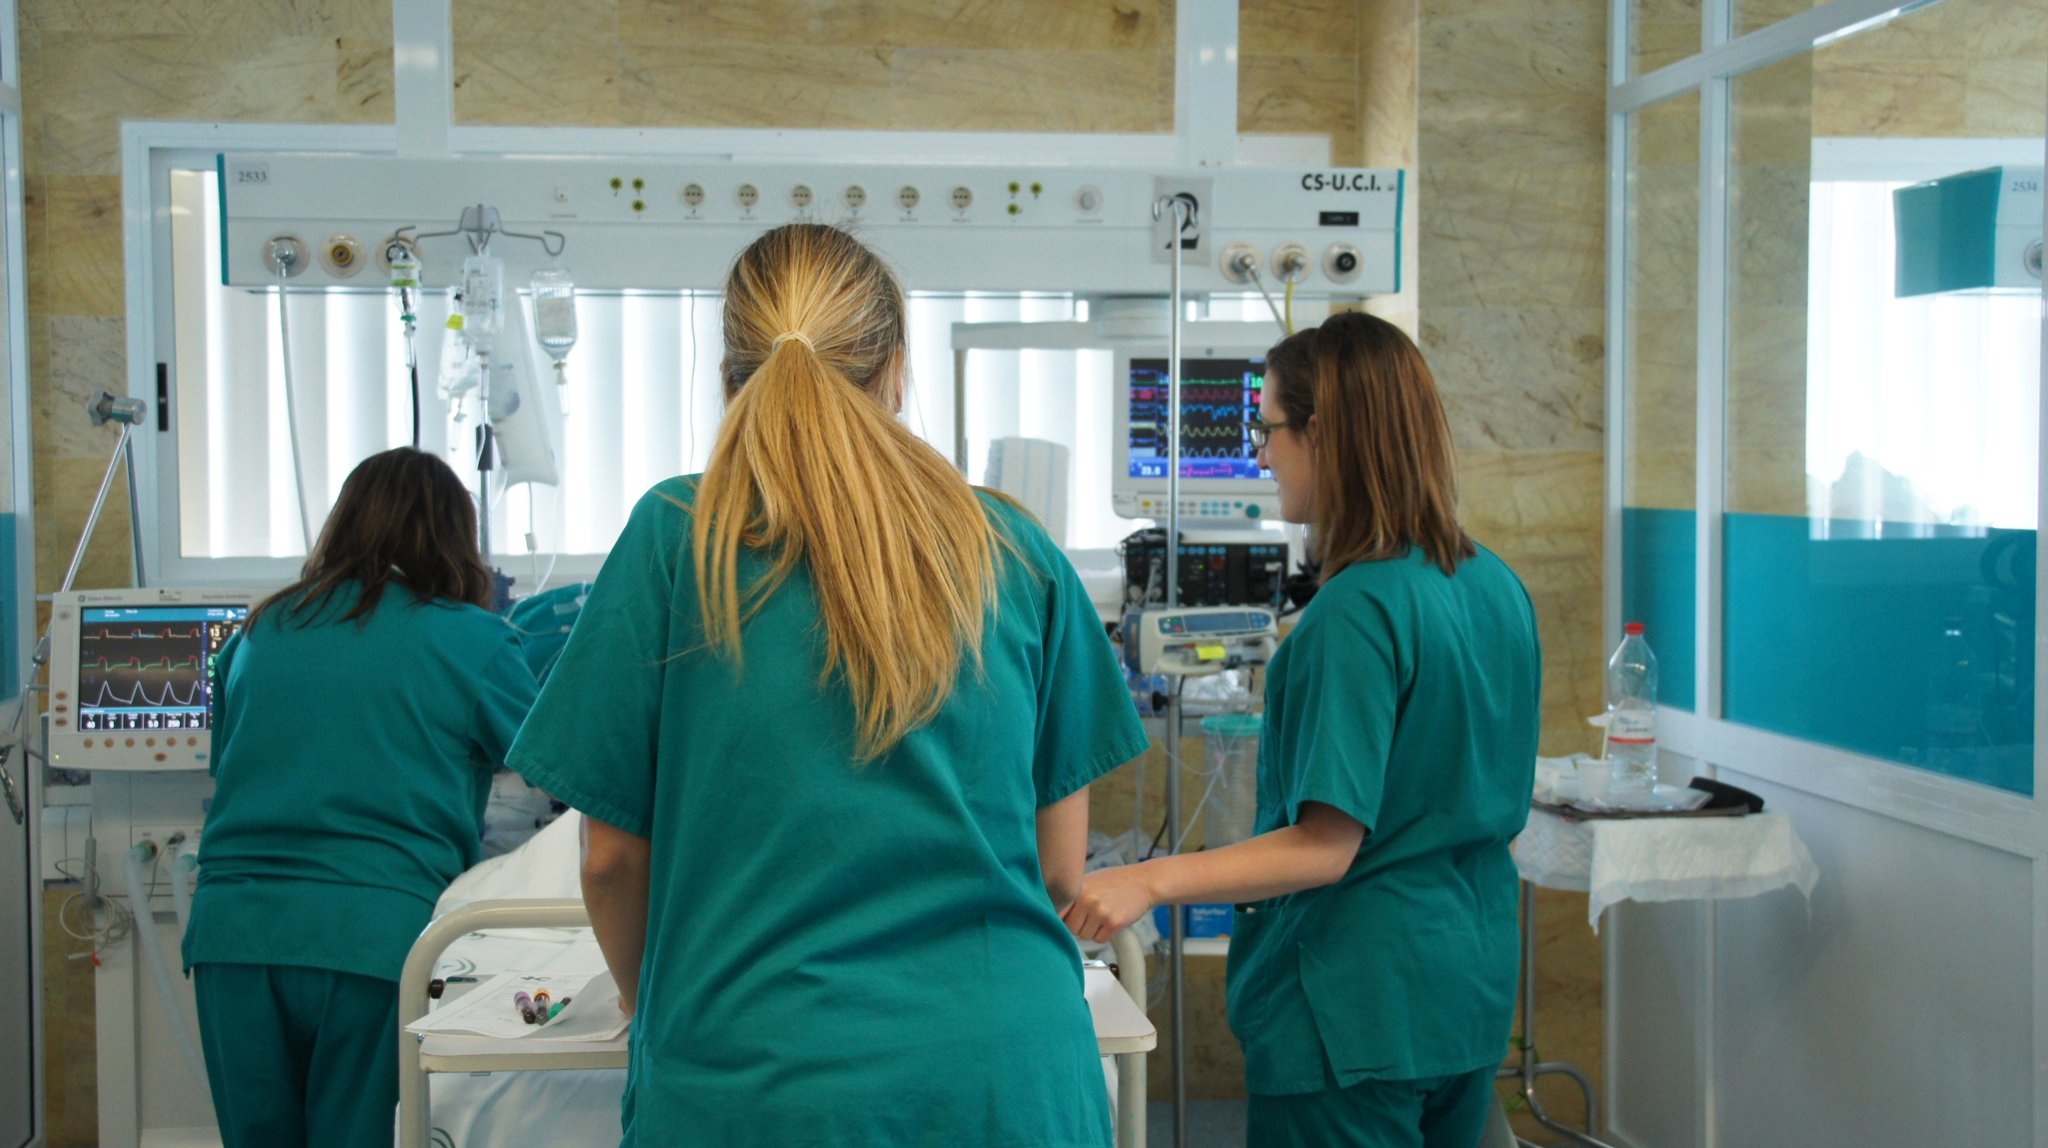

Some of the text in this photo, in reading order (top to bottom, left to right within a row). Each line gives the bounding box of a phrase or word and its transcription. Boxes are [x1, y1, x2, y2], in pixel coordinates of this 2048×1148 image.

[239, 171, 267, 183] 2533
[1301, 173, 1382, 191] CS-U.C.I.
[1165, 192, 1200, 250] 2
